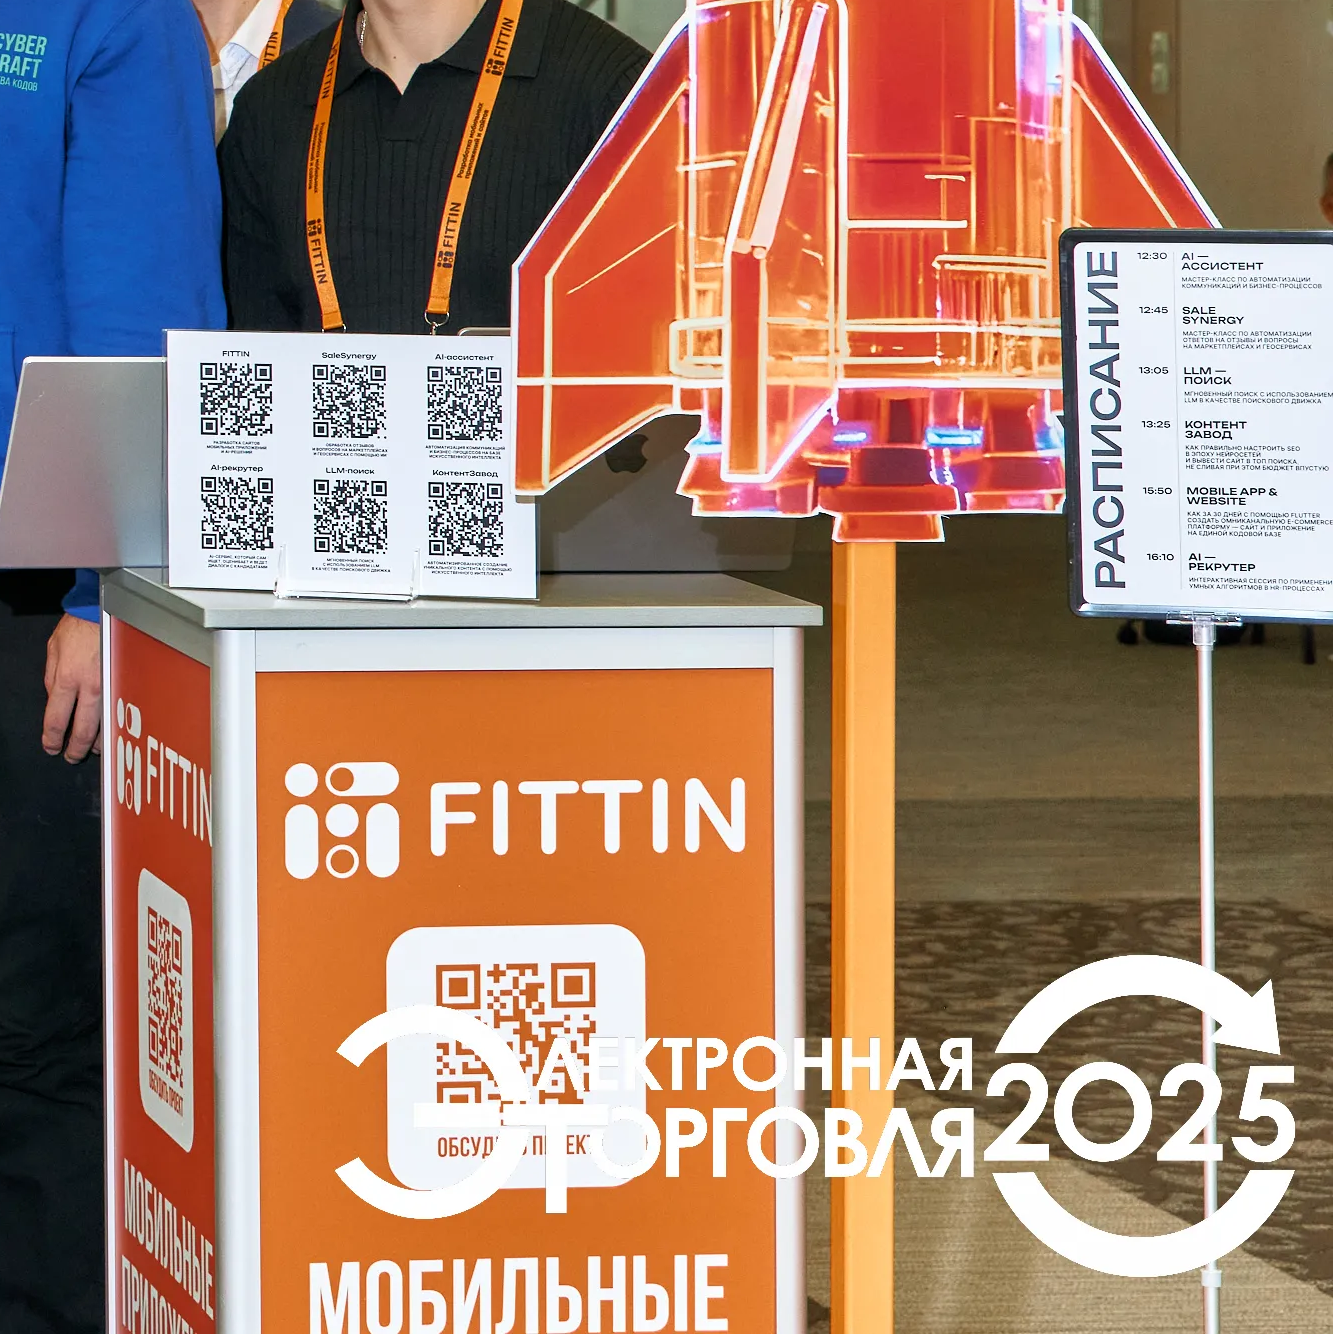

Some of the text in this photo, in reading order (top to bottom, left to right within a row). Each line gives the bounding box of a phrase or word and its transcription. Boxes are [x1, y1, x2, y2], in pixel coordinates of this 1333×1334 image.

[494, 17, 514, 58] FITTIN
[12, 78, 39, 92] КОДОВ
[443, 202, 461, 248] FITTIN
[1181, 262, 1263, 270] АССИСТЕНТ
[321, 351, 376, 360] SaleSynergy
[1087, 251, 1126, 589] РАСПИСАНИЕ
[1185, 420, 1247, 428] КОНТЕНТ
[1185, 430, 1232, 440] ЗАВОД
[432, 469, 498, 477] КонтентЗавод
[1188, 562, 1255, 571] РЕКРУТЕР
[147, 735, 213, 847] FITTIN
[430, 778, 746, 856] FITTIN
[123, 1158, 214, 1321] МОБИЛЬНЫЕ
[309, 1254, 729, 1334] МОБИЛЬНЫЕ
